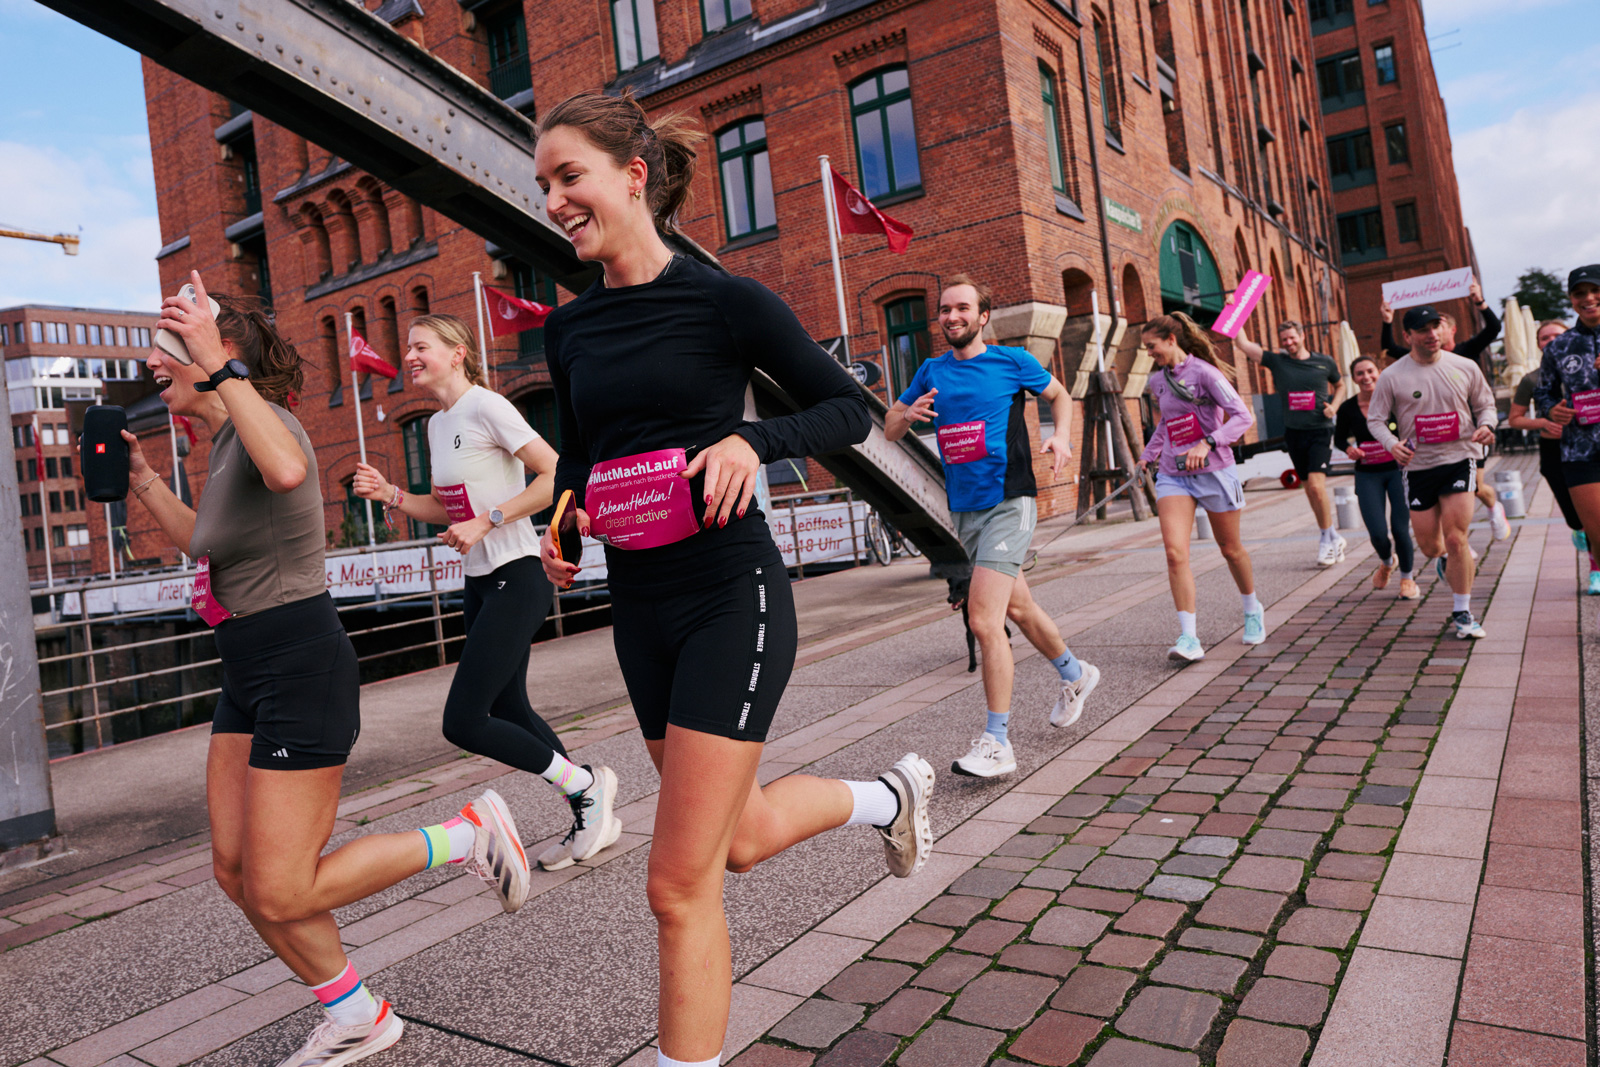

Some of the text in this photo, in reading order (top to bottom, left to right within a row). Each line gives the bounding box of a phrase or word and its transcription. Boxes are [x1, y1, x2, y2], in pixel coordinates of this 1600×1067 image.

[589, 456, 679, 485] #MutMachLauf
[593, 472, 679, 493] Gemeinsam stark nach Brustkrebs
[596, 481, 674, 519] LebensHeldin!
[818, 536, 844, 551] Uhr
[340, 562, 413, 588] Museum
[420, 556, 463, 582] Ham
[756, 623, 766, 652] STRONGER
[748, 662, 761, 692] STRONGER
[737, 701, 751, 731] STRONGE
